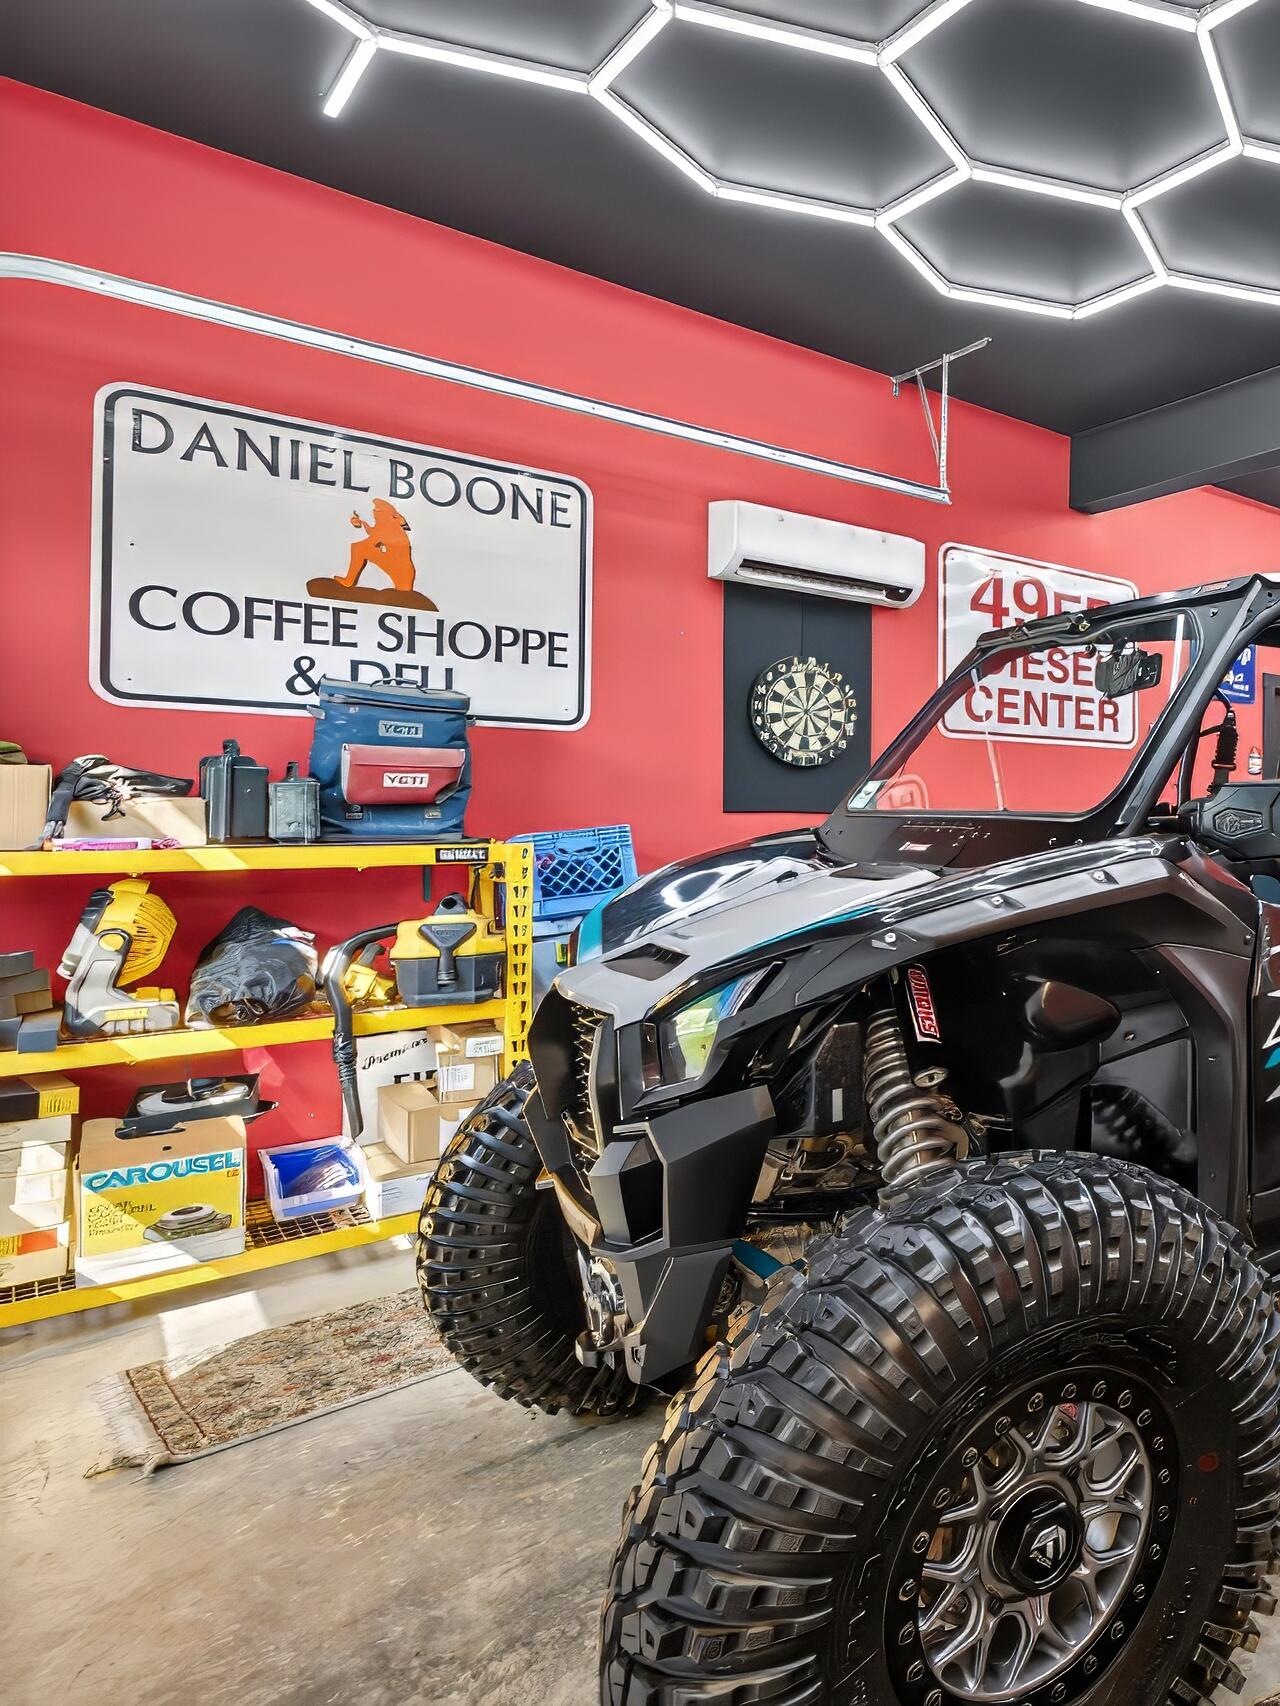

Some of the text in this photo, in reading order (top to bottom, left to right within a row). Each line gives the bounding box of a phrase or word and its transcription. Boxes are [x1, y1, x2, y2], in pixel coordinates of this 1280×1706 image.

[131, 408, 572, 529] DANIEL BOONE
[128, 585, 569, 668] COFFEE SHOPPE
[964, 685, 1120, 733] CENTER
[83, 1151, 241, 1193] CAROUSEL
